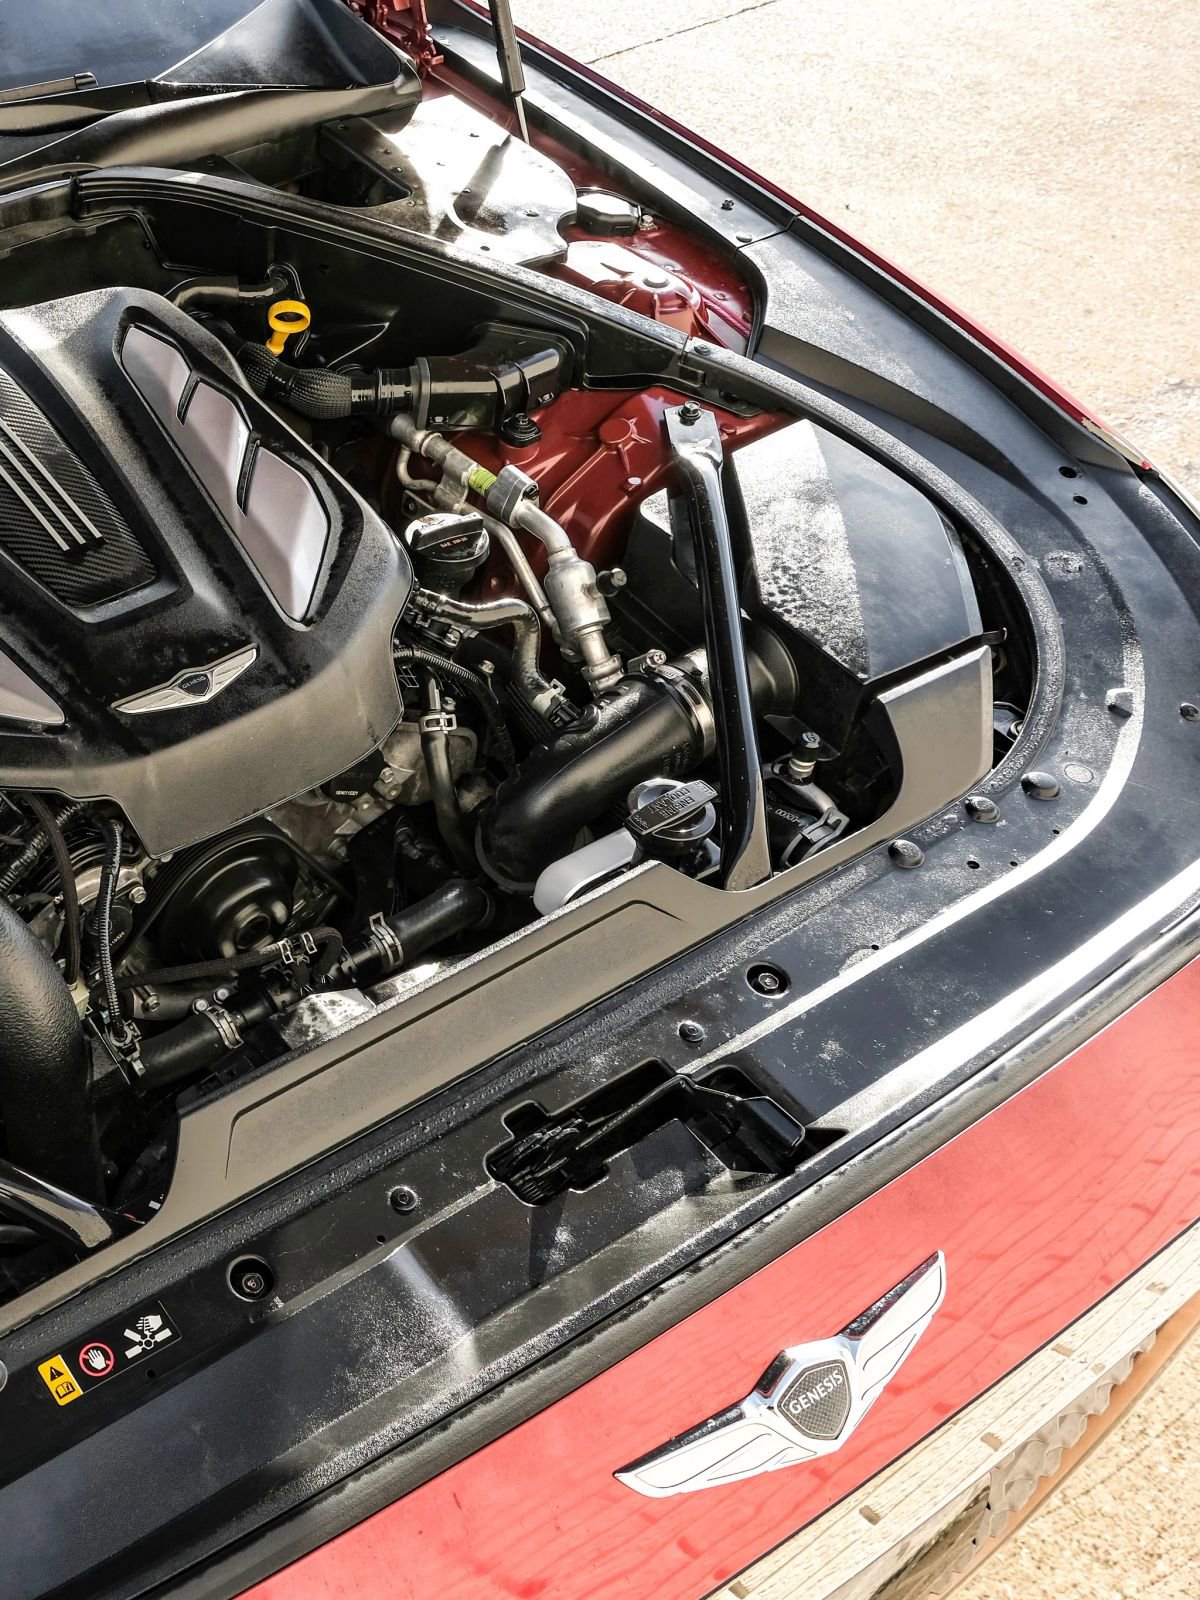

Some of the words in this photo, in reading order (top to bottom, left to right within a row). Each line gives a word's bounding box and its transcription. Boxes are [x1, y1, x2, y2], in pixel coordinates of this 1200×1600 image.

[182, 675, 207, 689] GENESIS
[647, 787, 691, 815] COOLANT
[659, 797, 695, 819] ENGINE
[789, 1368, 844, 1415] GENESIS
